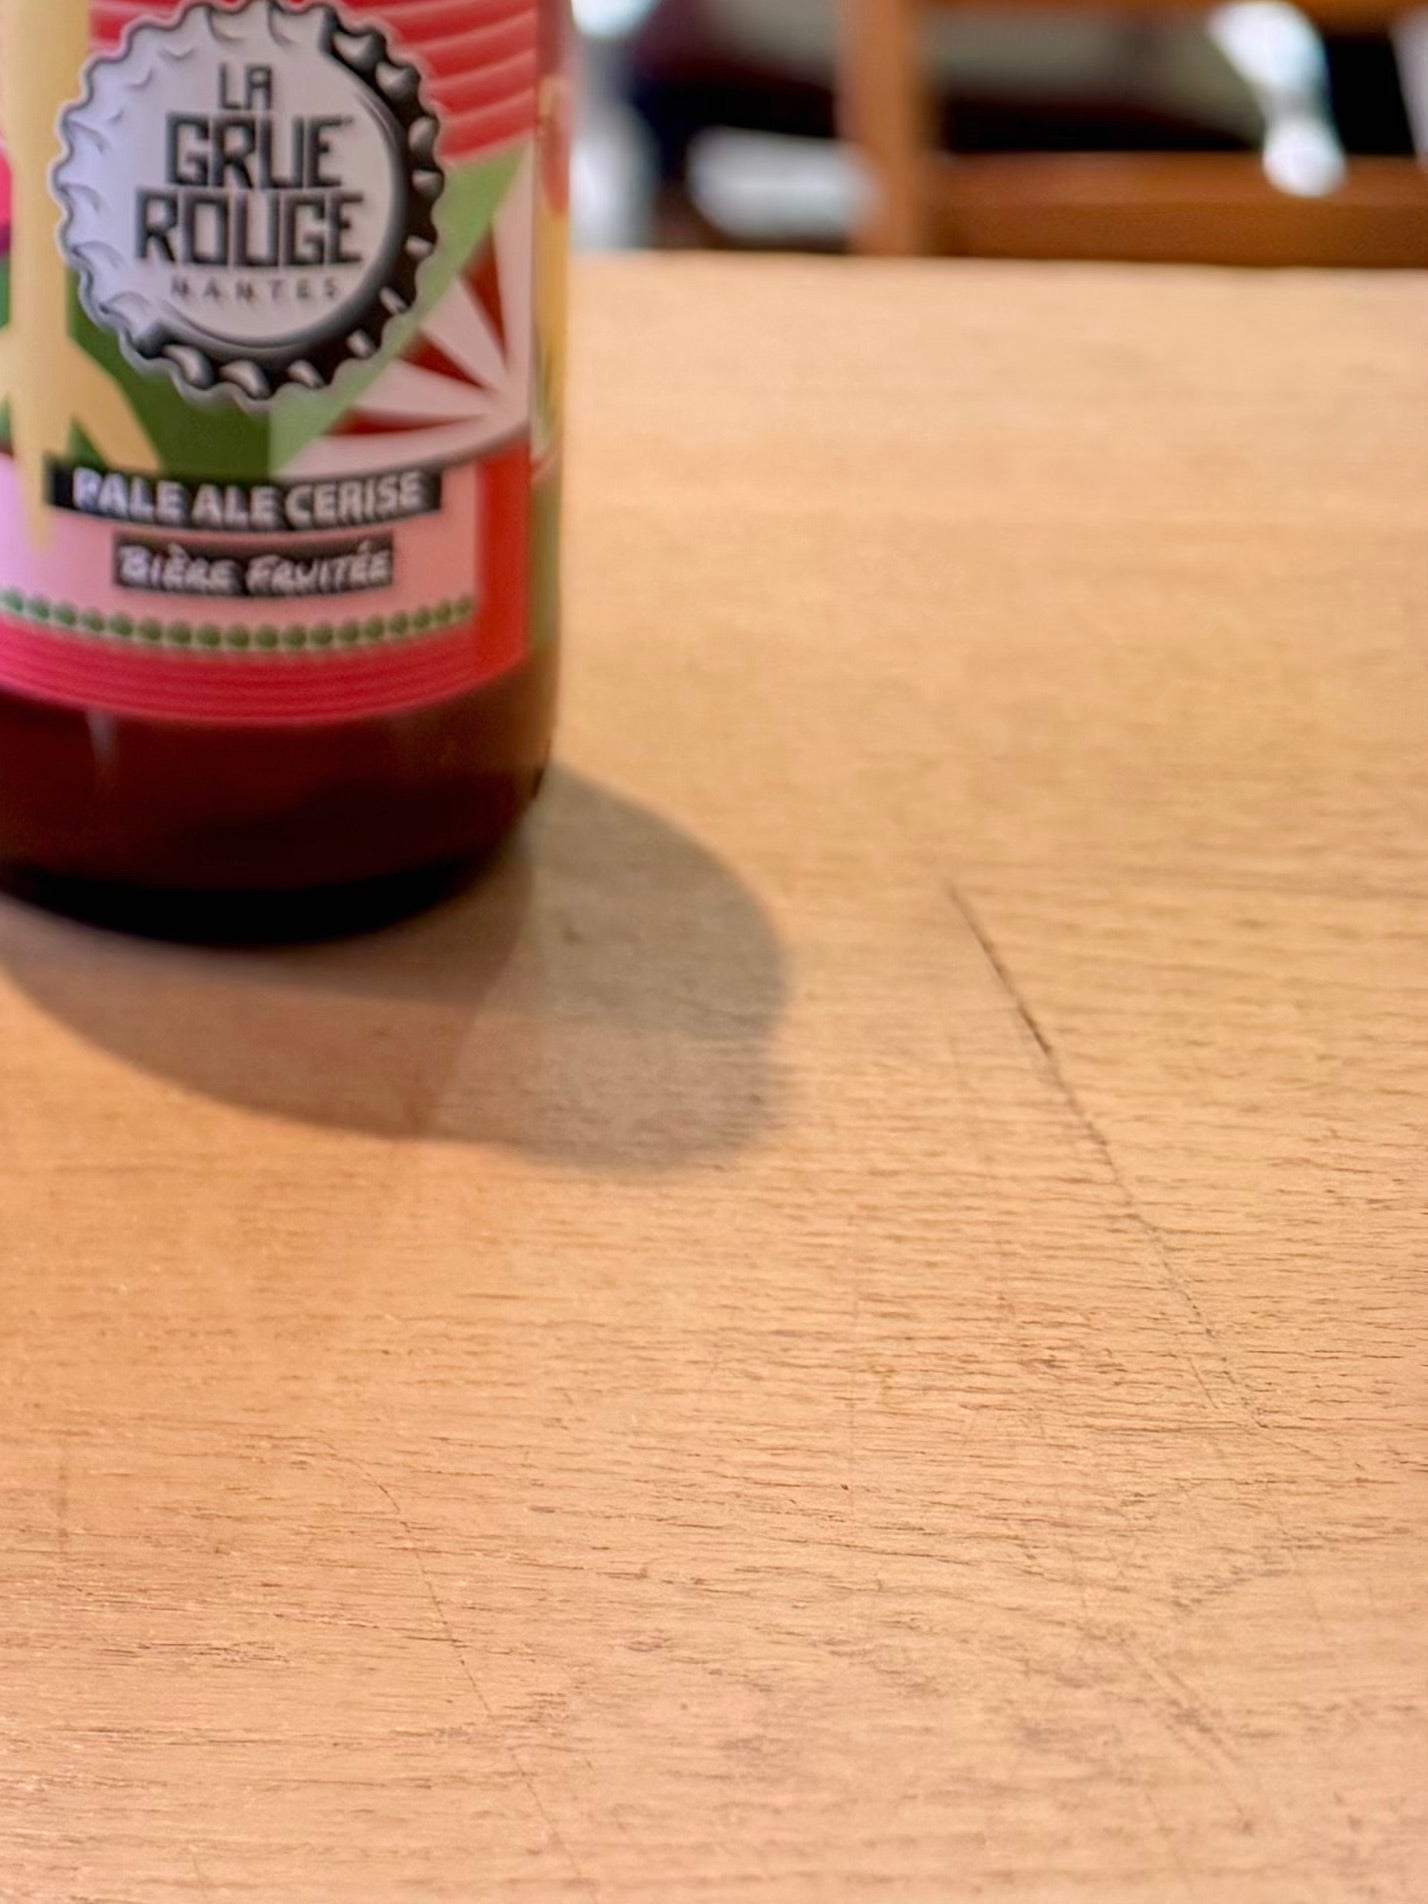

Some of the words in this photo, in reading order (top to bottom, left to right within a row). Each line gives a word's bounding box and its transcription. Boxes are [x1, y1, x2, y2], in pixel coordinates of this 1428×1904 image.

[218, 62, 273, 110] LA
[166, 115, 353, 188] GRUE
[137, 190, 364, 266] ROUGE
[172, 278, 338, 299] NANTES
[73, 468, 184, 519] PALE
[192, 479, 277, 526] ALE
[283, 470, 426, 522] CERISE
